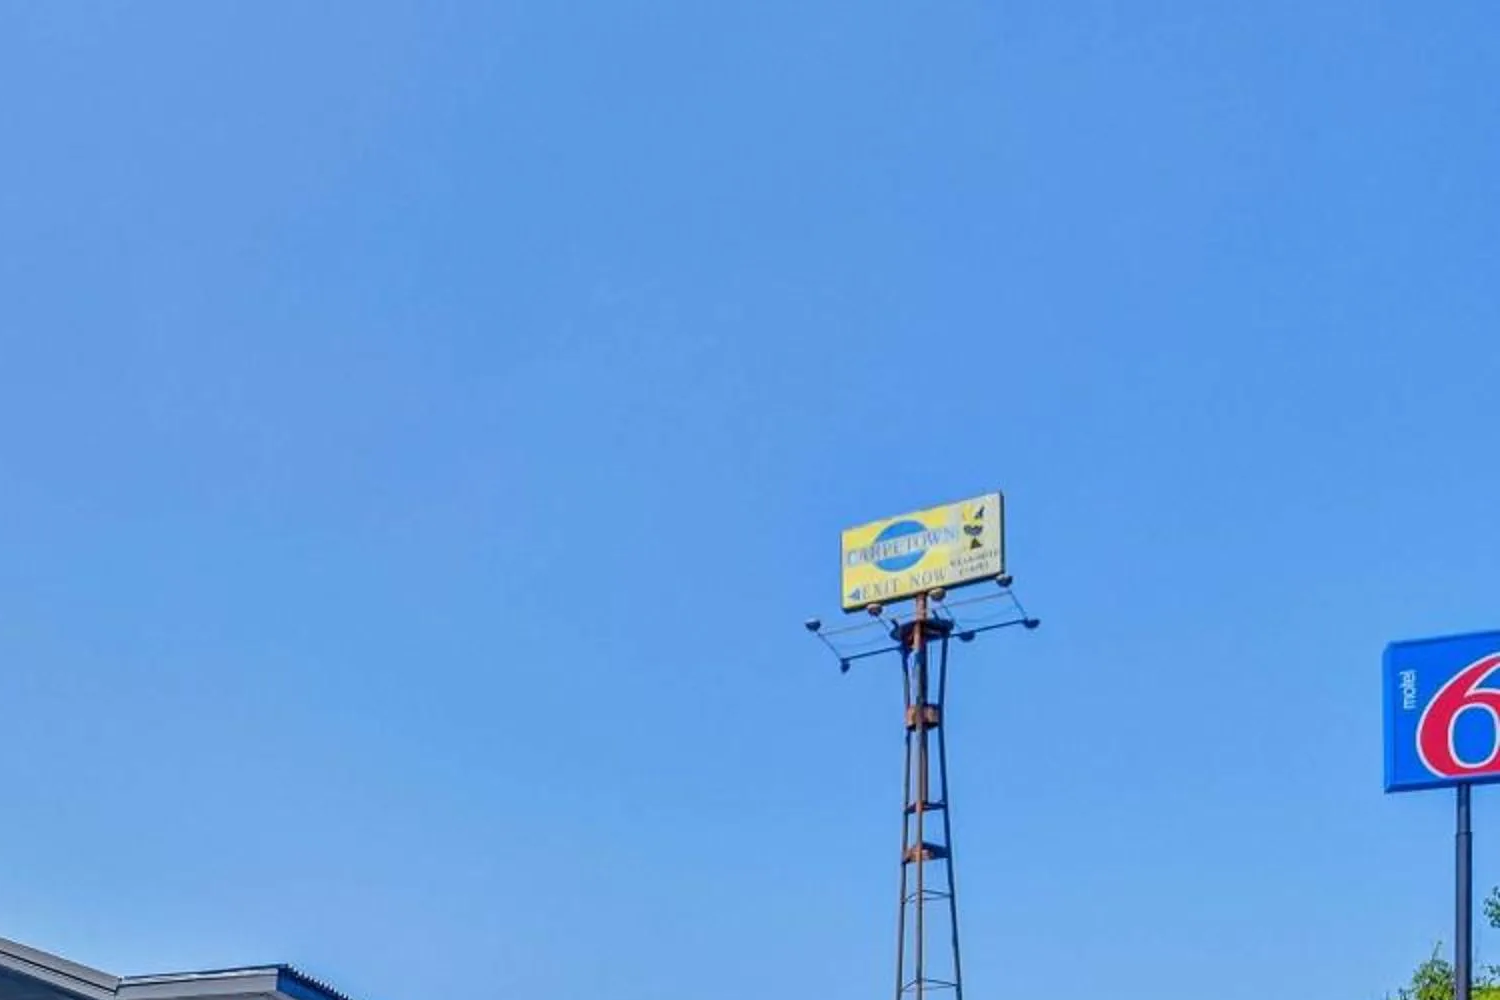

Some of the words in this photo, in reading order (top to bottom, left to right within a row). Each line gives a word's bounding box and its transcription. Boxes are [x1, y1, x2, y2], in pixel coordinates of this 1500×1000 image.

[864, 578, 899, 599] EXIT
[911, 567, 947, 587] NOW
[1400, 669, 1417, 709] motel
[1416, 652, 1500, 778] 6
